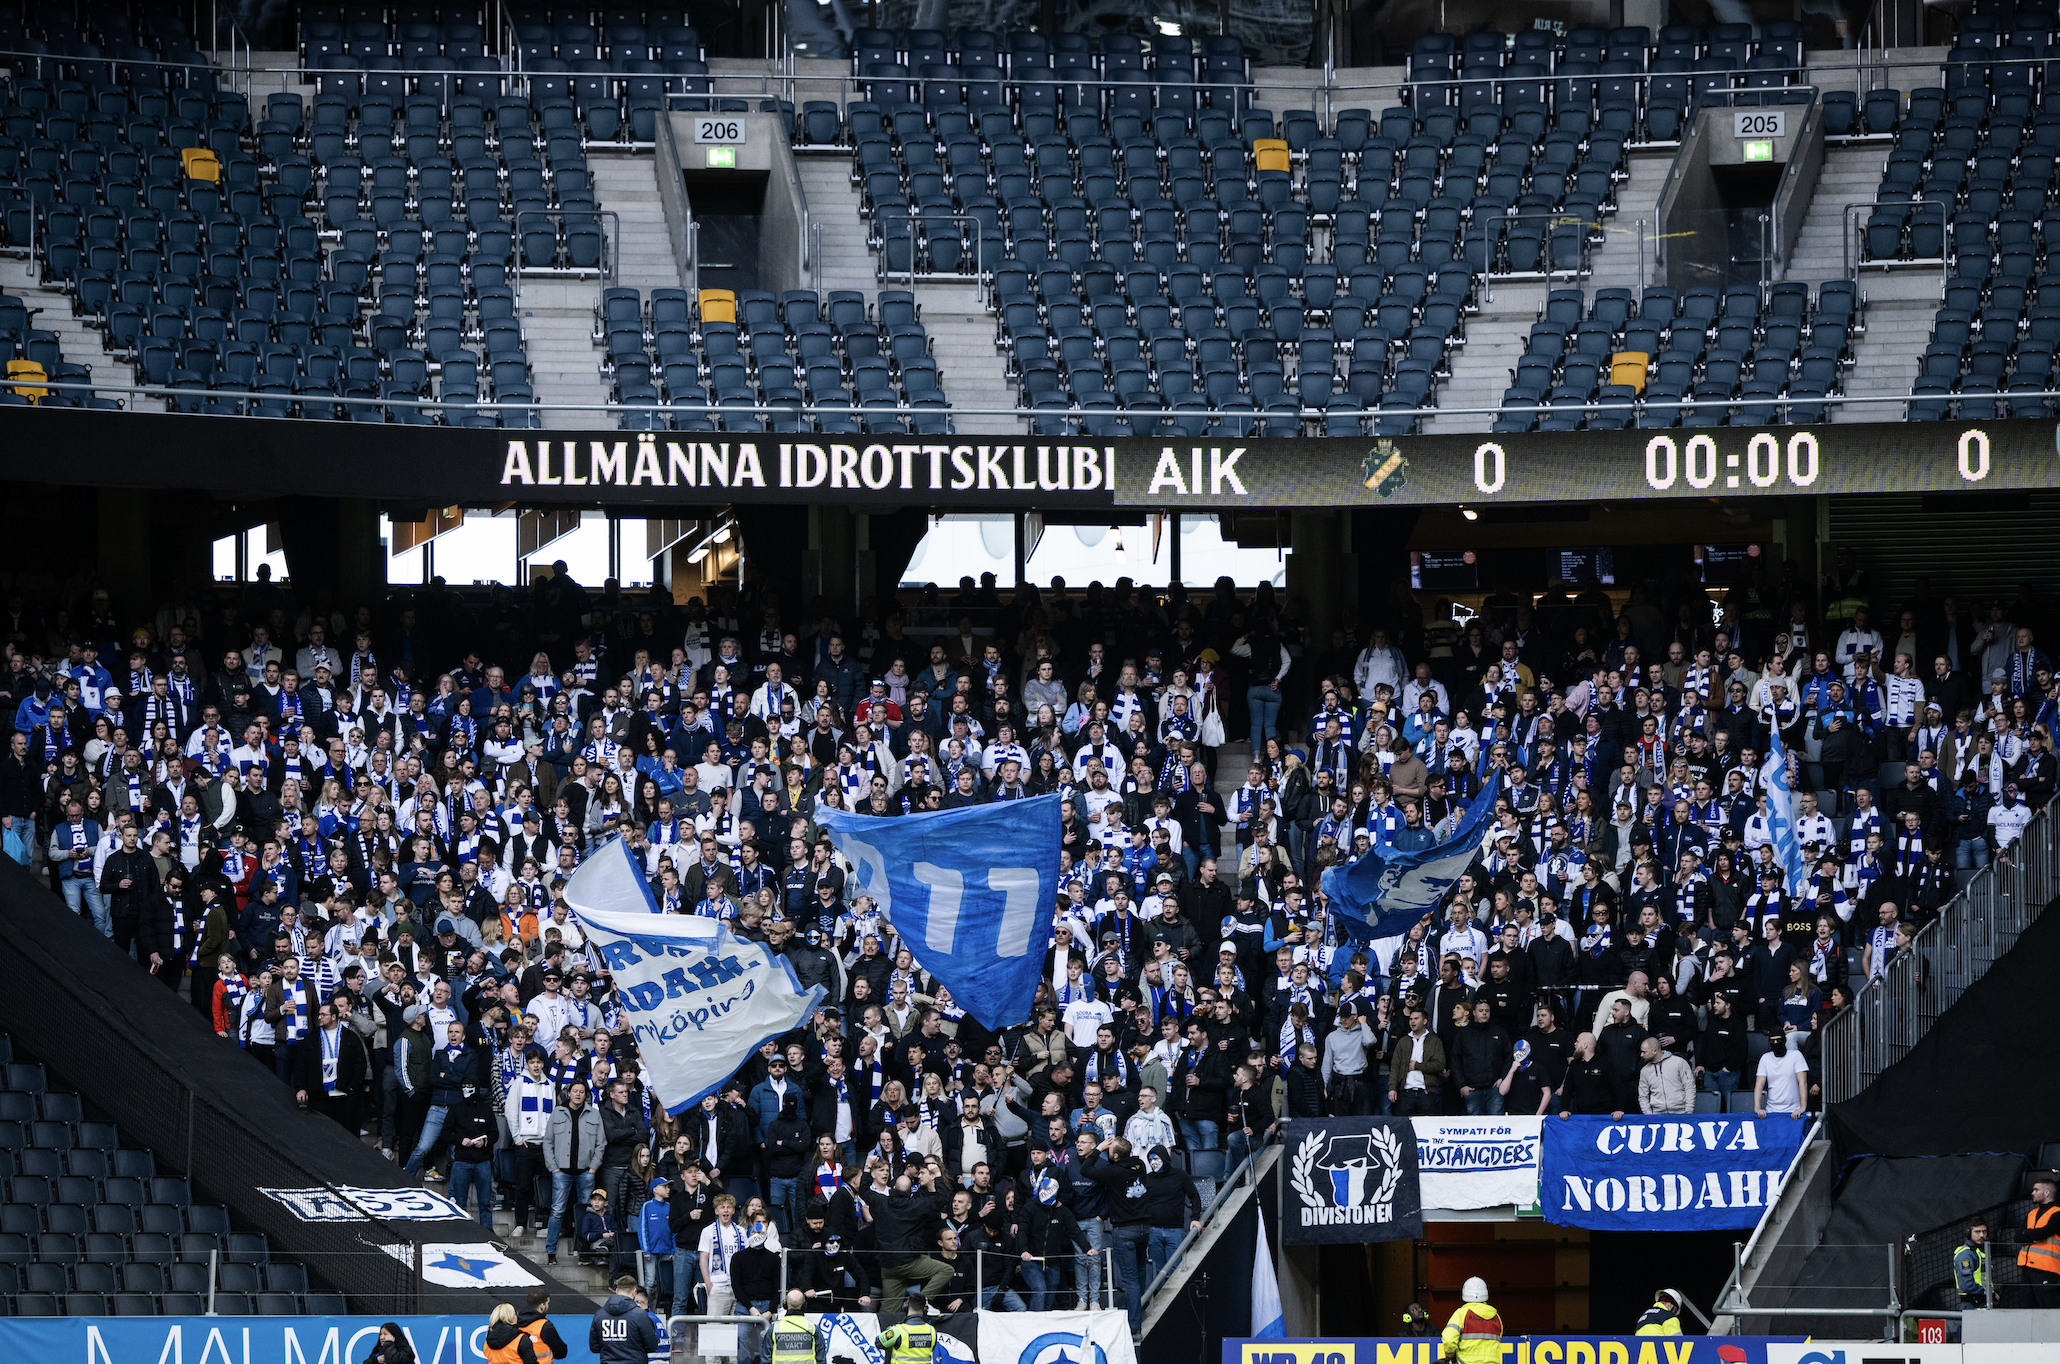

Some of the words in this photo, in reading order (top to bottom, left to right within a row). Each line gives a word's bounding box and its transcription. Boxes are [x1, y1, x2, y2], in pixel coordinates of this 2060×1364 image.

[702, 122, 738, 139] 206
[1741, 116, 1778, 132] 205
[500, 433, 766, 487] ALLMÄNNA
[1148, 446, 1248, 496] AIK
[1473, 442, 1507, 495] 0
[1644, 431, 1820, 490] 00:00
[1957, 428, 1991, 483] 0
[1786, 922, 1812, 932] BOSS
[1439, 1127, 1487, 1136] SYMPATI
[1490, 1125, 1512, 1136] FÖR
[1596, 1121, 1760, 1155] CURVA
[1301, 1202, 1393, 1227] DIVISIONEN
[601, 1319, 628, 1338] SLO
[1920, 1327, 1942, 1344] 103
[776, 1333, 812, 1342] ORDNINGS
[785, 1342, 804, 1350] VAKT
